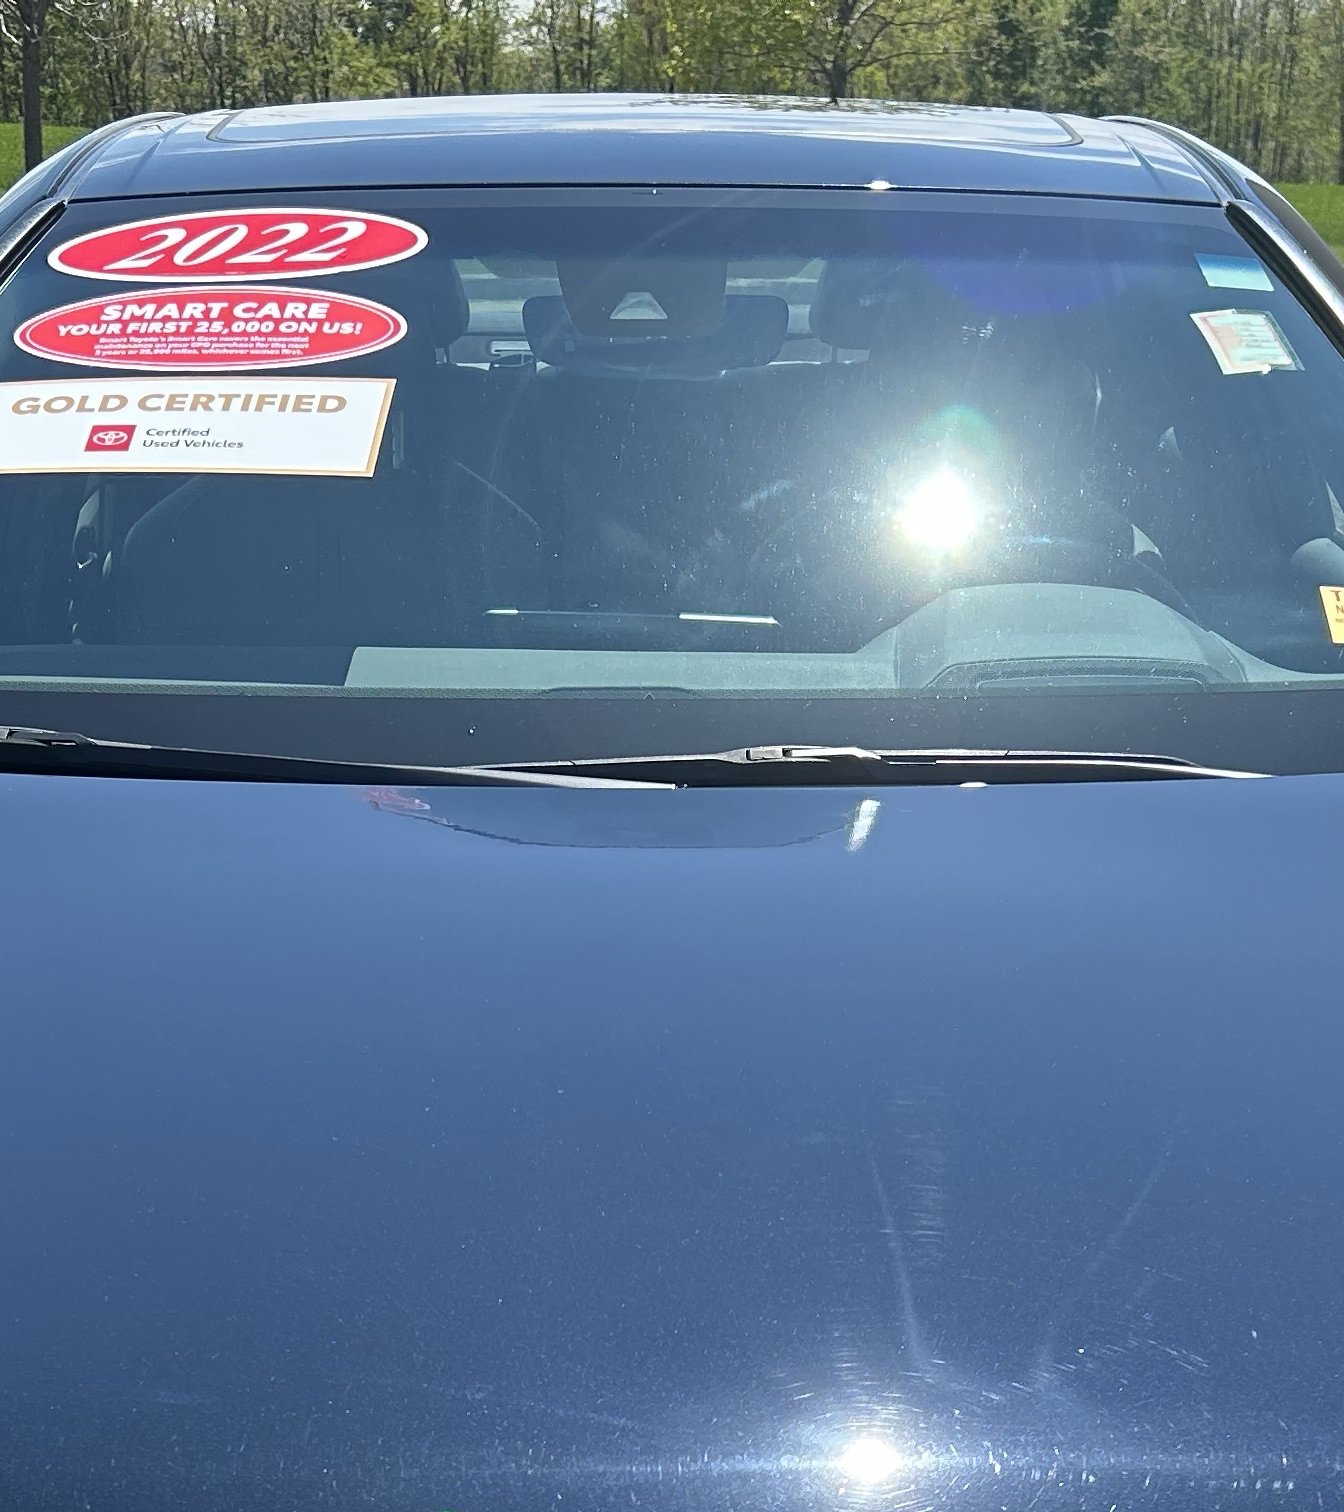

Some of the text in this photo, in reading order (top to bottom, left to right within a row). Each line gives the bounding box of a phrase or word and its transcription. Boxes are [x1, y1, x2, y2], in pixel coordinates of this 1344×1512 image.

[103, 221, 367, 270] 2022
[100, 302, 330, 321] SMART CARE
[58, 320, 364, 337] YOUR FIRST 25,000 ON US!
[11, 393, 348, 415] GOLD CERTIFIED
[146, 428, 210, 437] Certified
[142, 439, 244, 449] Used Vehicles
